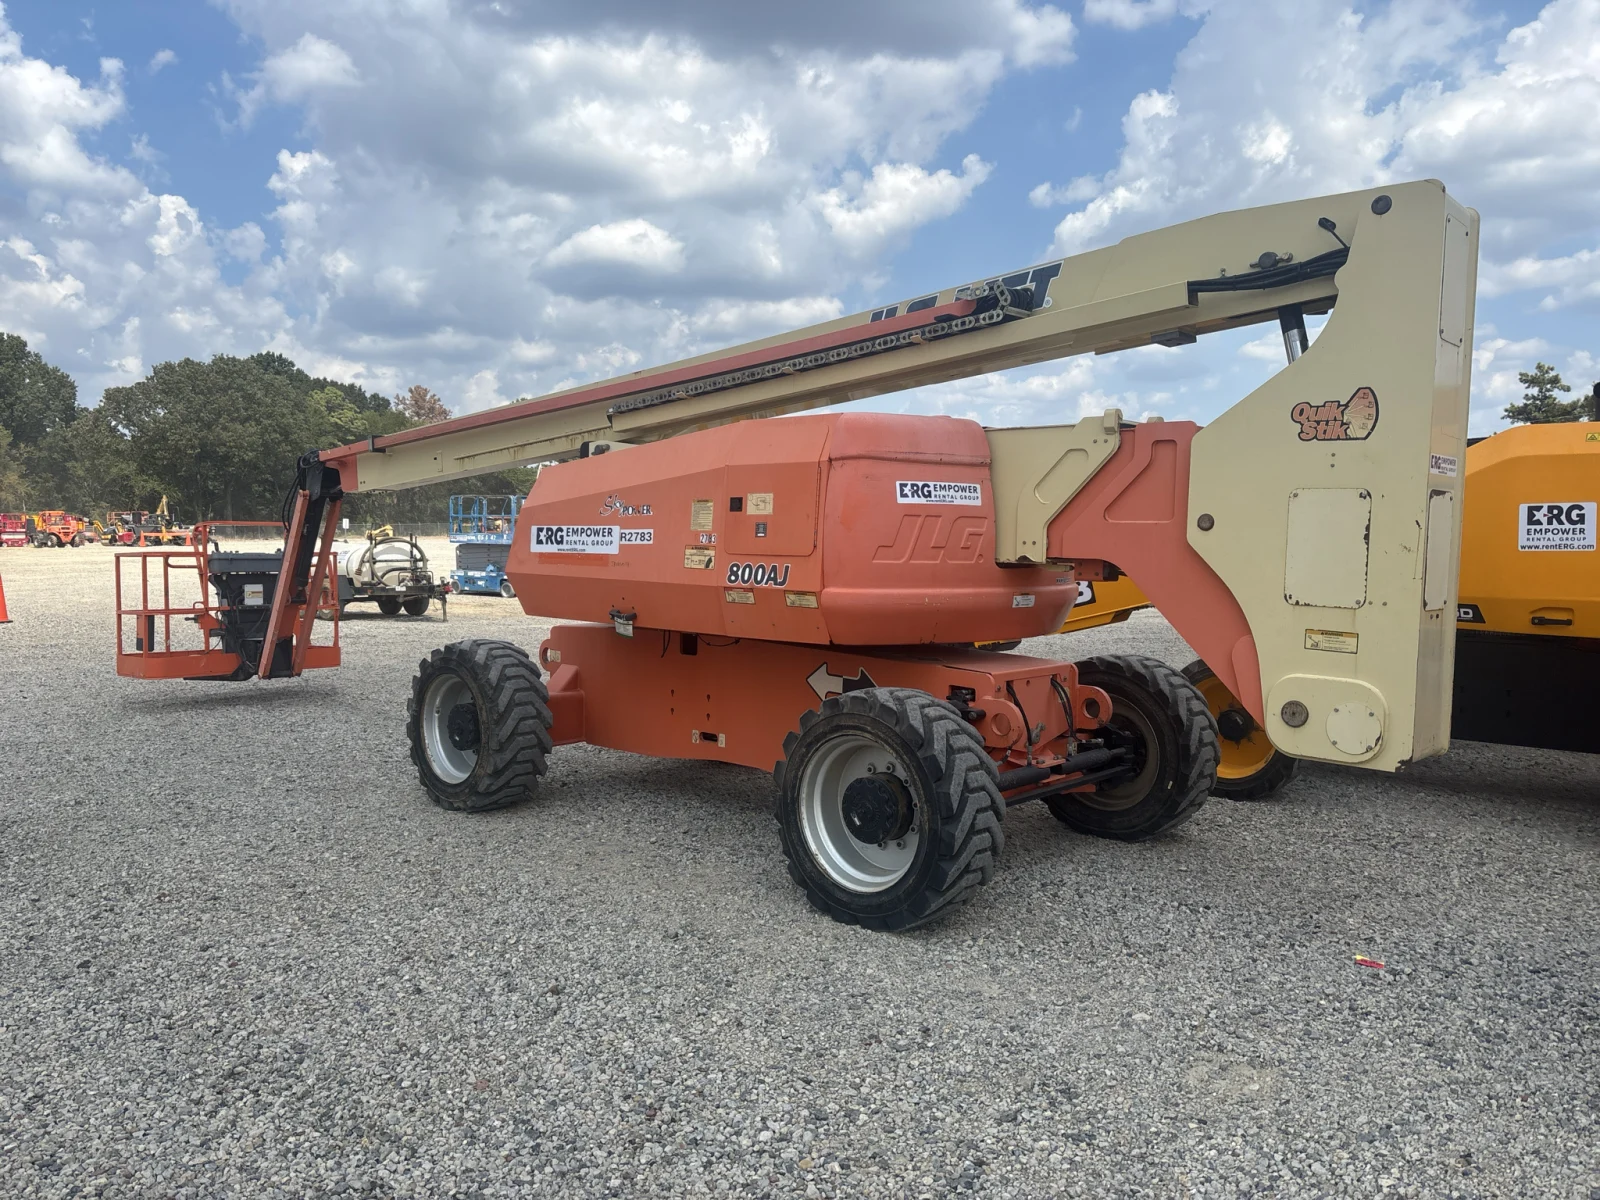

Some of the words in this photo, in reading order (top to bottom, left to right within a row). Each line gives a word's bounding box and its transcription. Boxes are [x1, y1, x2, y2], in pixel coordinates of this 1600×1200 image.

[1292, 401, 1346, 424] Quik
[1299, 420, 1349, 440] Stik
[899, 482, 932, 499] ERG
[933, 484, 979, 494] EMPOWER
[1526, 503, 1586, 526] ERG
[536, 526, 564, 546] ERG
[565, 527, 613, 538] EMPOWER
[620, 531, 653, 543] R2783
[1526, 527, 1586, 536] EMPOWER
[726, 562, 791, 588] 800AJ
